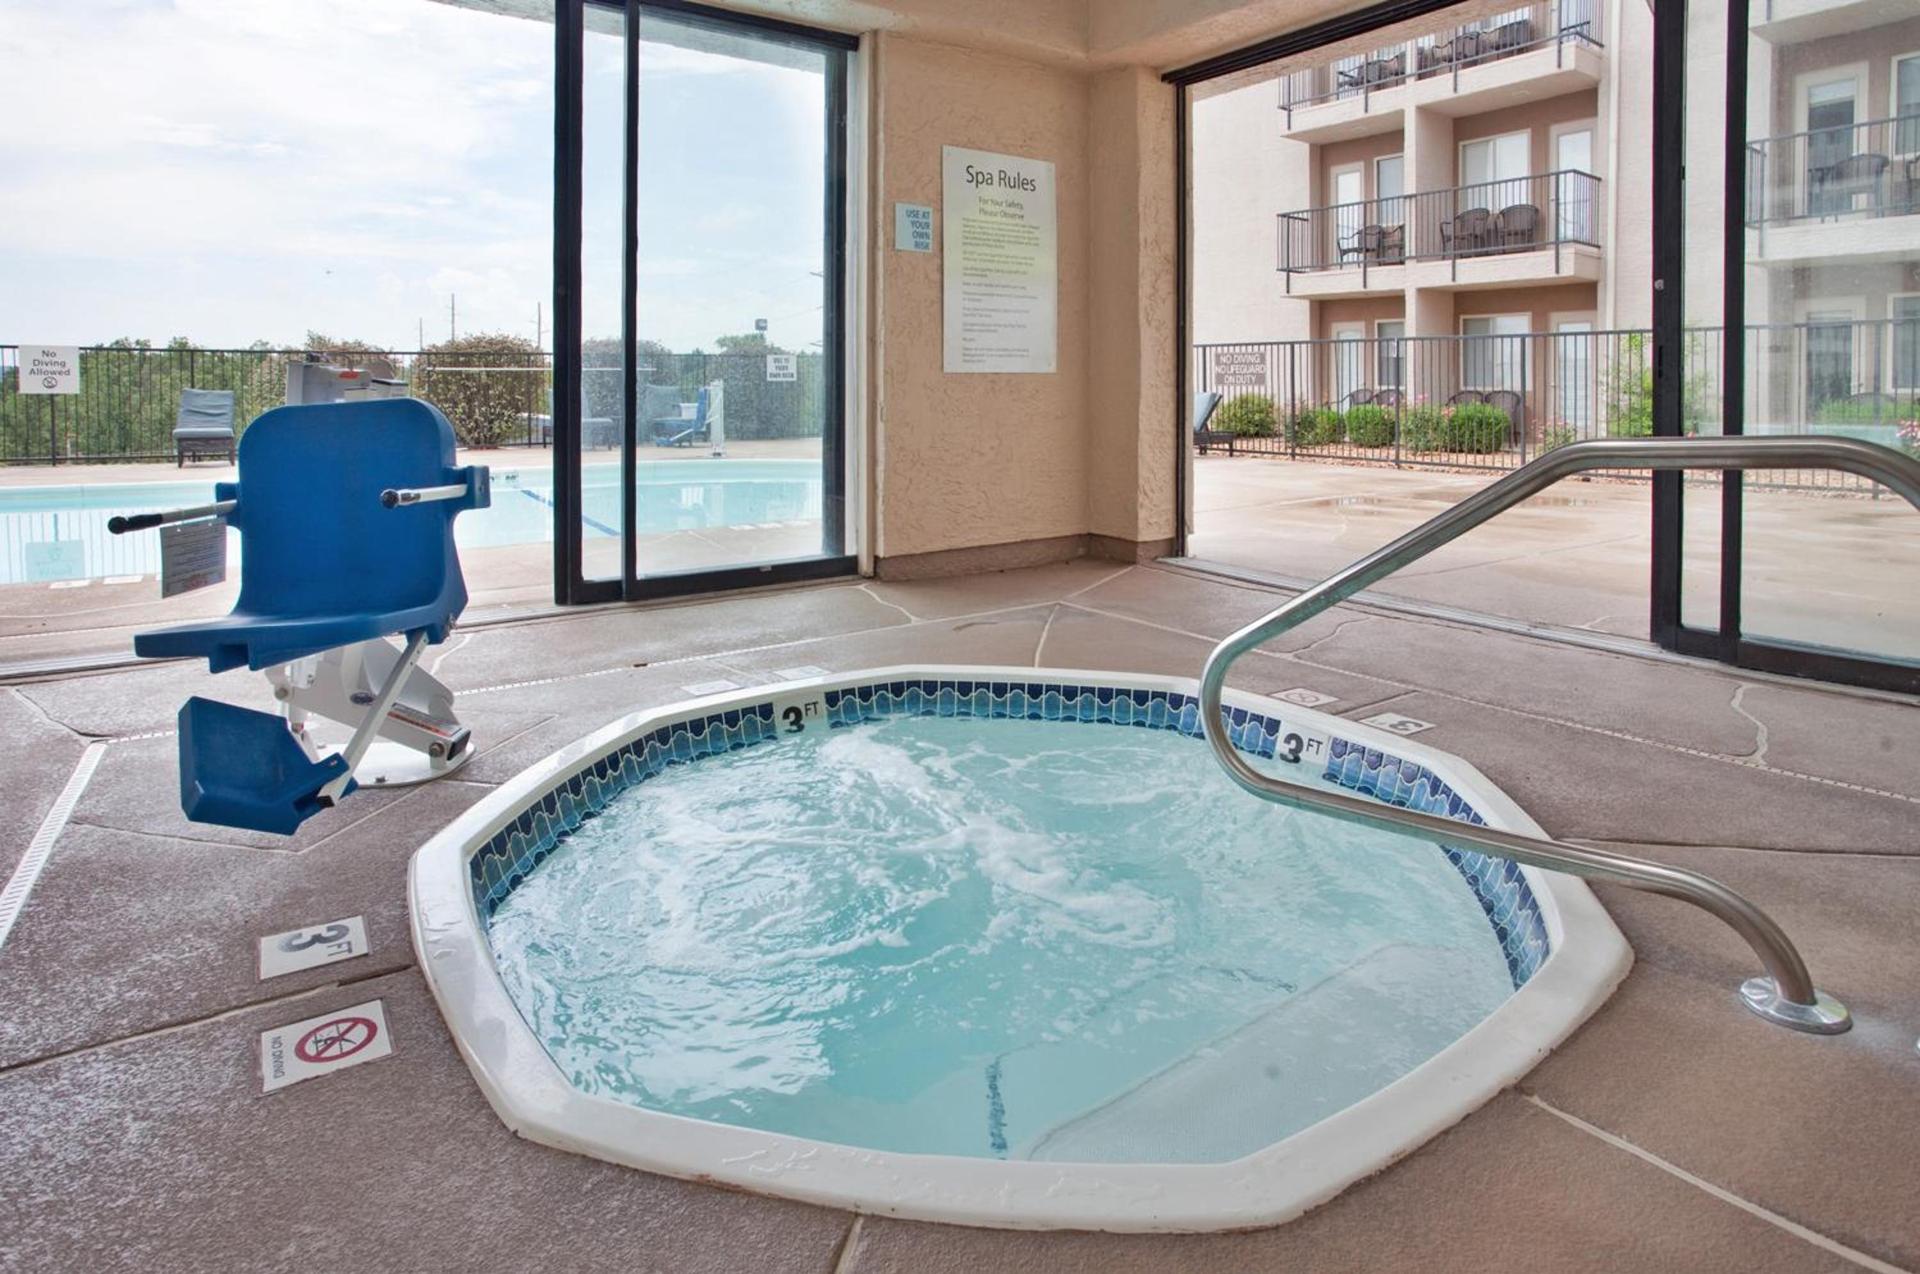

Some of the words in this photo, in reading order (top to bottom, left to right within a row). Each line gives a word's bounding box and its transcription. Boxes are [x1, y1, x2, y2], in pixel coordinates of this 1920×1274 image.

[965, 164, 994, 189] Spa
[998, 169, 1037, 192] Rules
[905, 208, 921, 219] USE
[922, 210, 931, 220] AT
[911, 219, 931, 230] YOUR
[912, 230, 931, 241] OWN
[41, 349, 57, 359] No
[1219, 353, 1232, 364] NO
[1233, 353, 1261, 364] DIVING
[32, 359, 67, 369] Diving
[1215, 364, 1226, 374] NO
[1227, 364, 1266, 374] LIFEGUARD
[29, 367, 71, 377] Allowed
[1224, 374, 1235, 384] ON
[1236, 374, 1257, 385] DUTY
[781, 705, 805, 733] 3
[804, 701, 819, 718] FT
[1279, 732, 1304, 764] 3
[1305, 738, 1324, 756] FT
[279, 923, 350, 953] 3
[327, 940, 353, 957] FT
[271, 1035, 284, 1049] NO
[271, 1050, 286, 1080] DIVING
